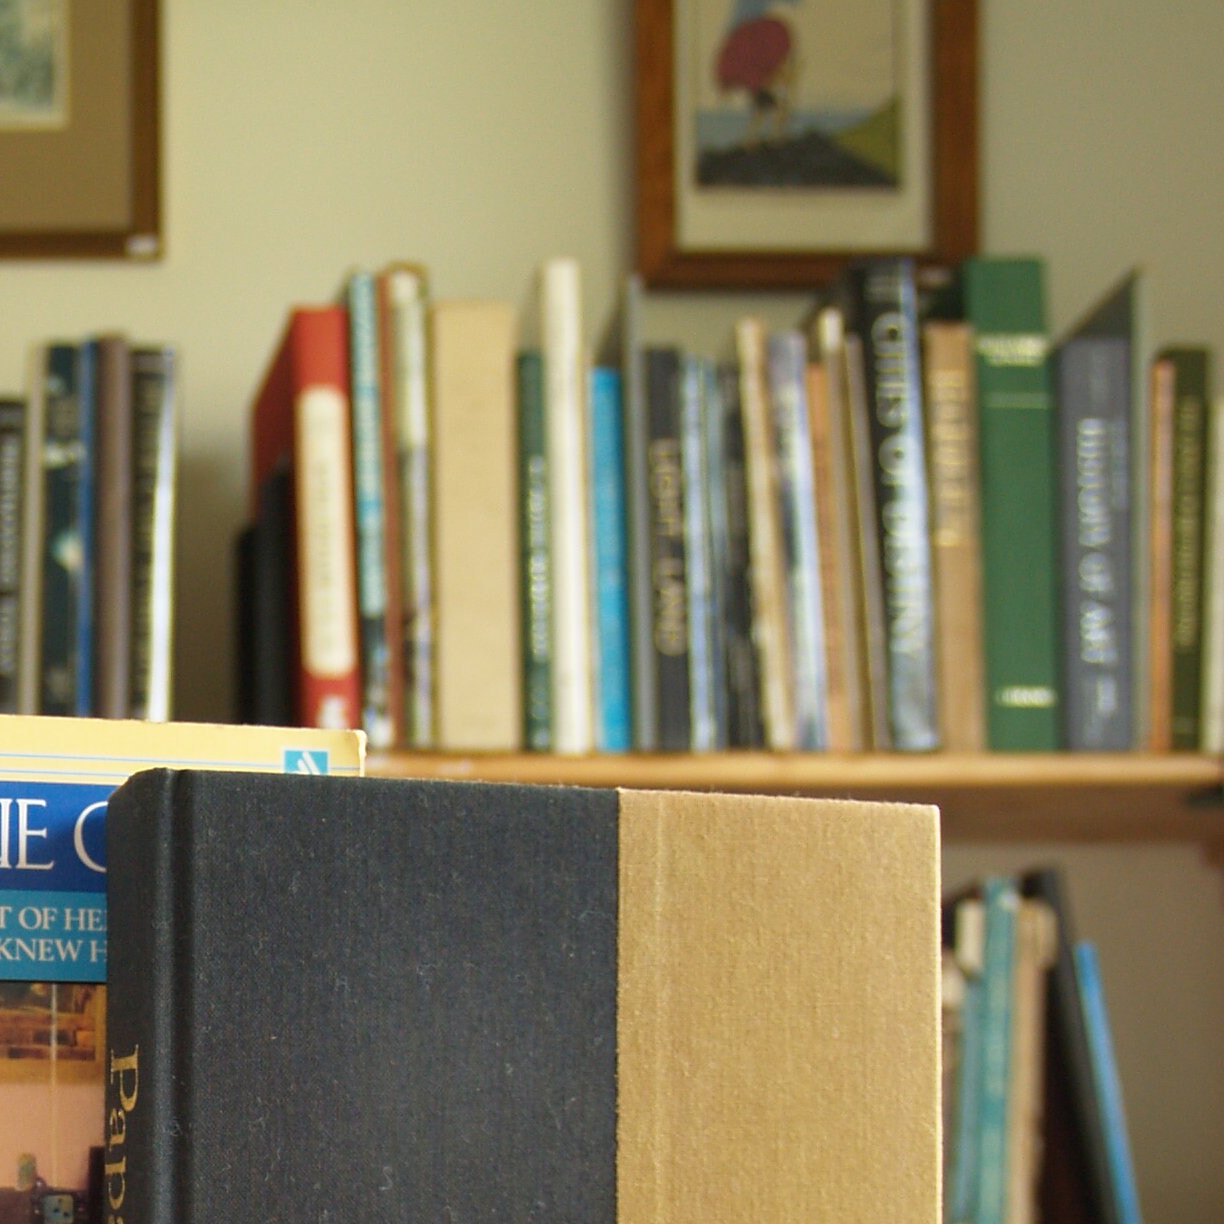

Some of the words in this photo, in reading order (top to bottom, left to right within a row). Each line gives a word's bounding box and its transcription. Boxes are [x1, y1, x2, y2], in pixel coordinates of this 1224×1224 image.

[878, 434, 921, 489] OF
[18, 906, 58, 931] OF
[64, 908, 107, 932] HE
